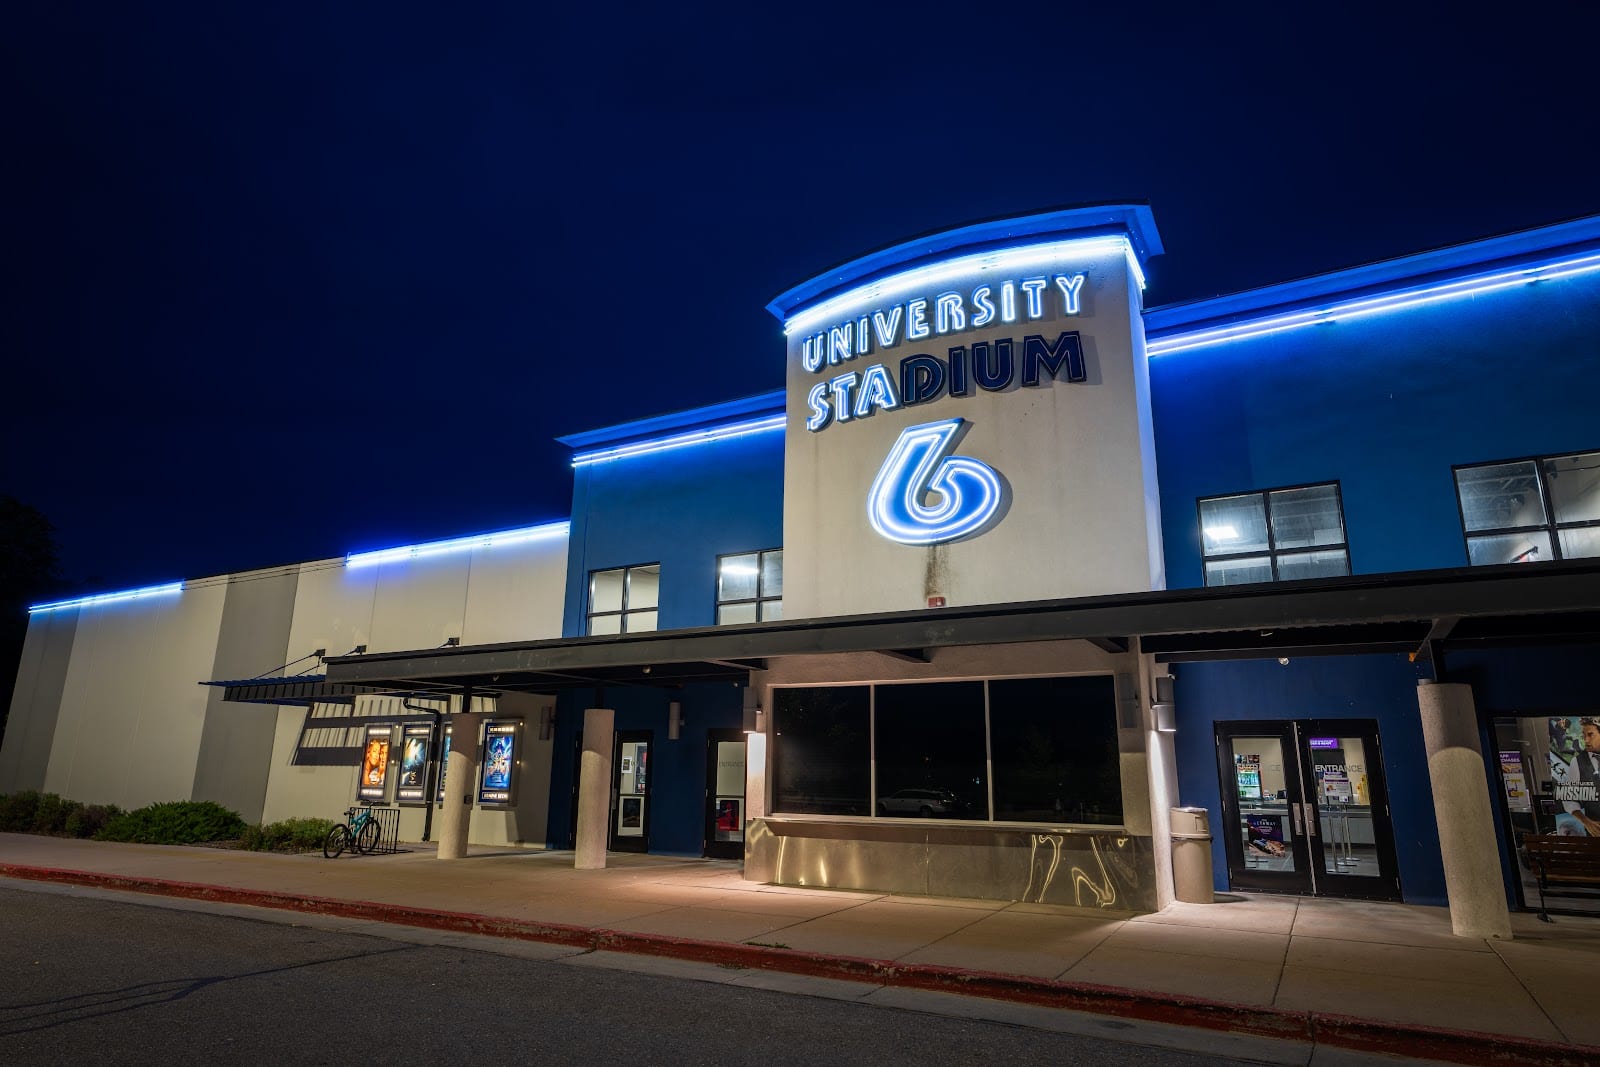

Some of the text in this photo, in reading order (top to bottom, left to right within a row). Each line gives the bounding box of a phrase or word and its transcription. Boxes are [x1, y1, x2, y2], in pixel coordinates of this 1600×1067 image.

[802, 271, 1088, 373] UNIVERSITY
[806, 331, 1087, 432] STADIUM
[867, 417, 1001, 545] 6
[1314, 764, 1363, 773] ENTRANCE
[1556, 787, 1599, 801] MISSION:
